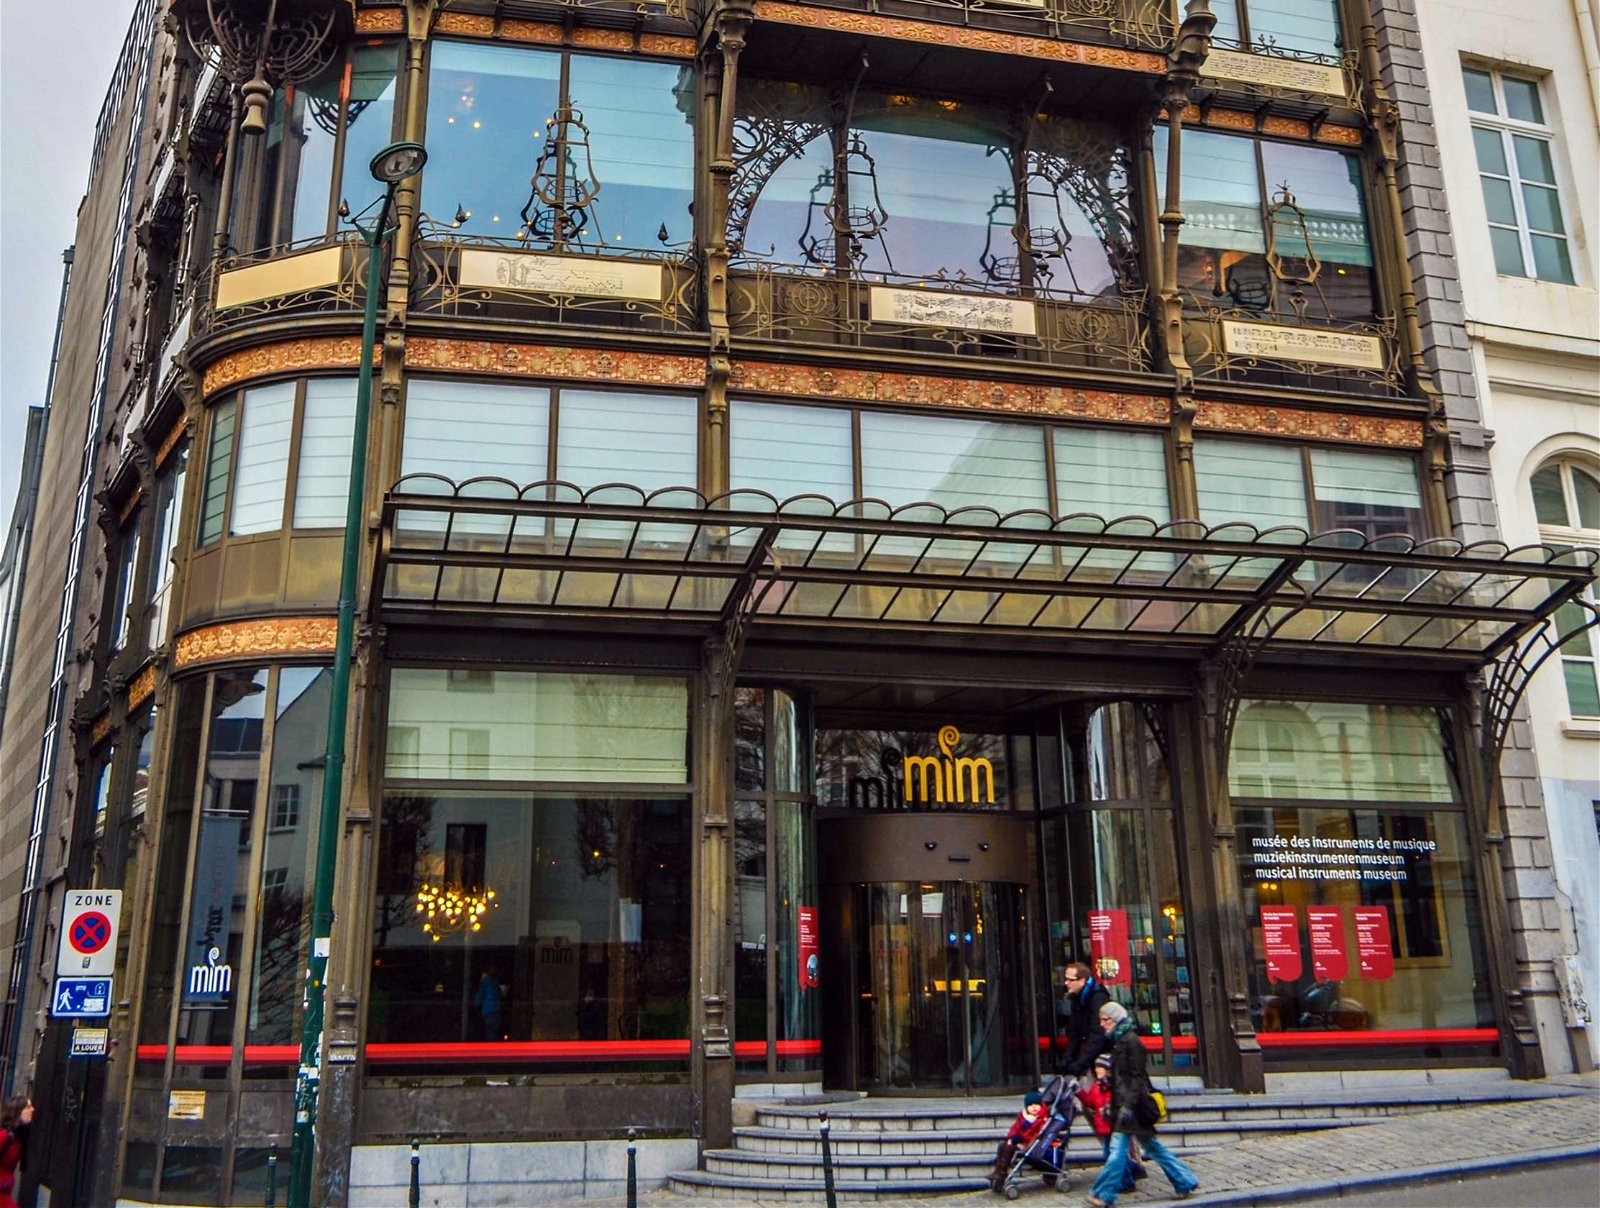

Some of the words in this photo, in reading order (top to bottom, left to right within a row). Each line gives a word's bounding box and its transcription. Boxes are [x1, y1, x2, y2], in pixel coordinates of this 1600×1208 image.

[904, 725, 995, 803] mim
[1252, 834, 1288, 847] musée
[1290, 835, 1311, 848] des
[1312, 836, 1375, 849] instruments
[1376, 837, 1391, 850] de
[1392, 838, 1436, 853] musique
[1253, 850, 1405, 865] muziekinstrumentenmuseum
[1255, 866, 1297, 879] musical
[1298, 867, 1362, 880] instruments
[1363, 870, 1408, 880] museum
[75, 895, 113, 906] ZONE
[190, 947, 232, 993] mim
